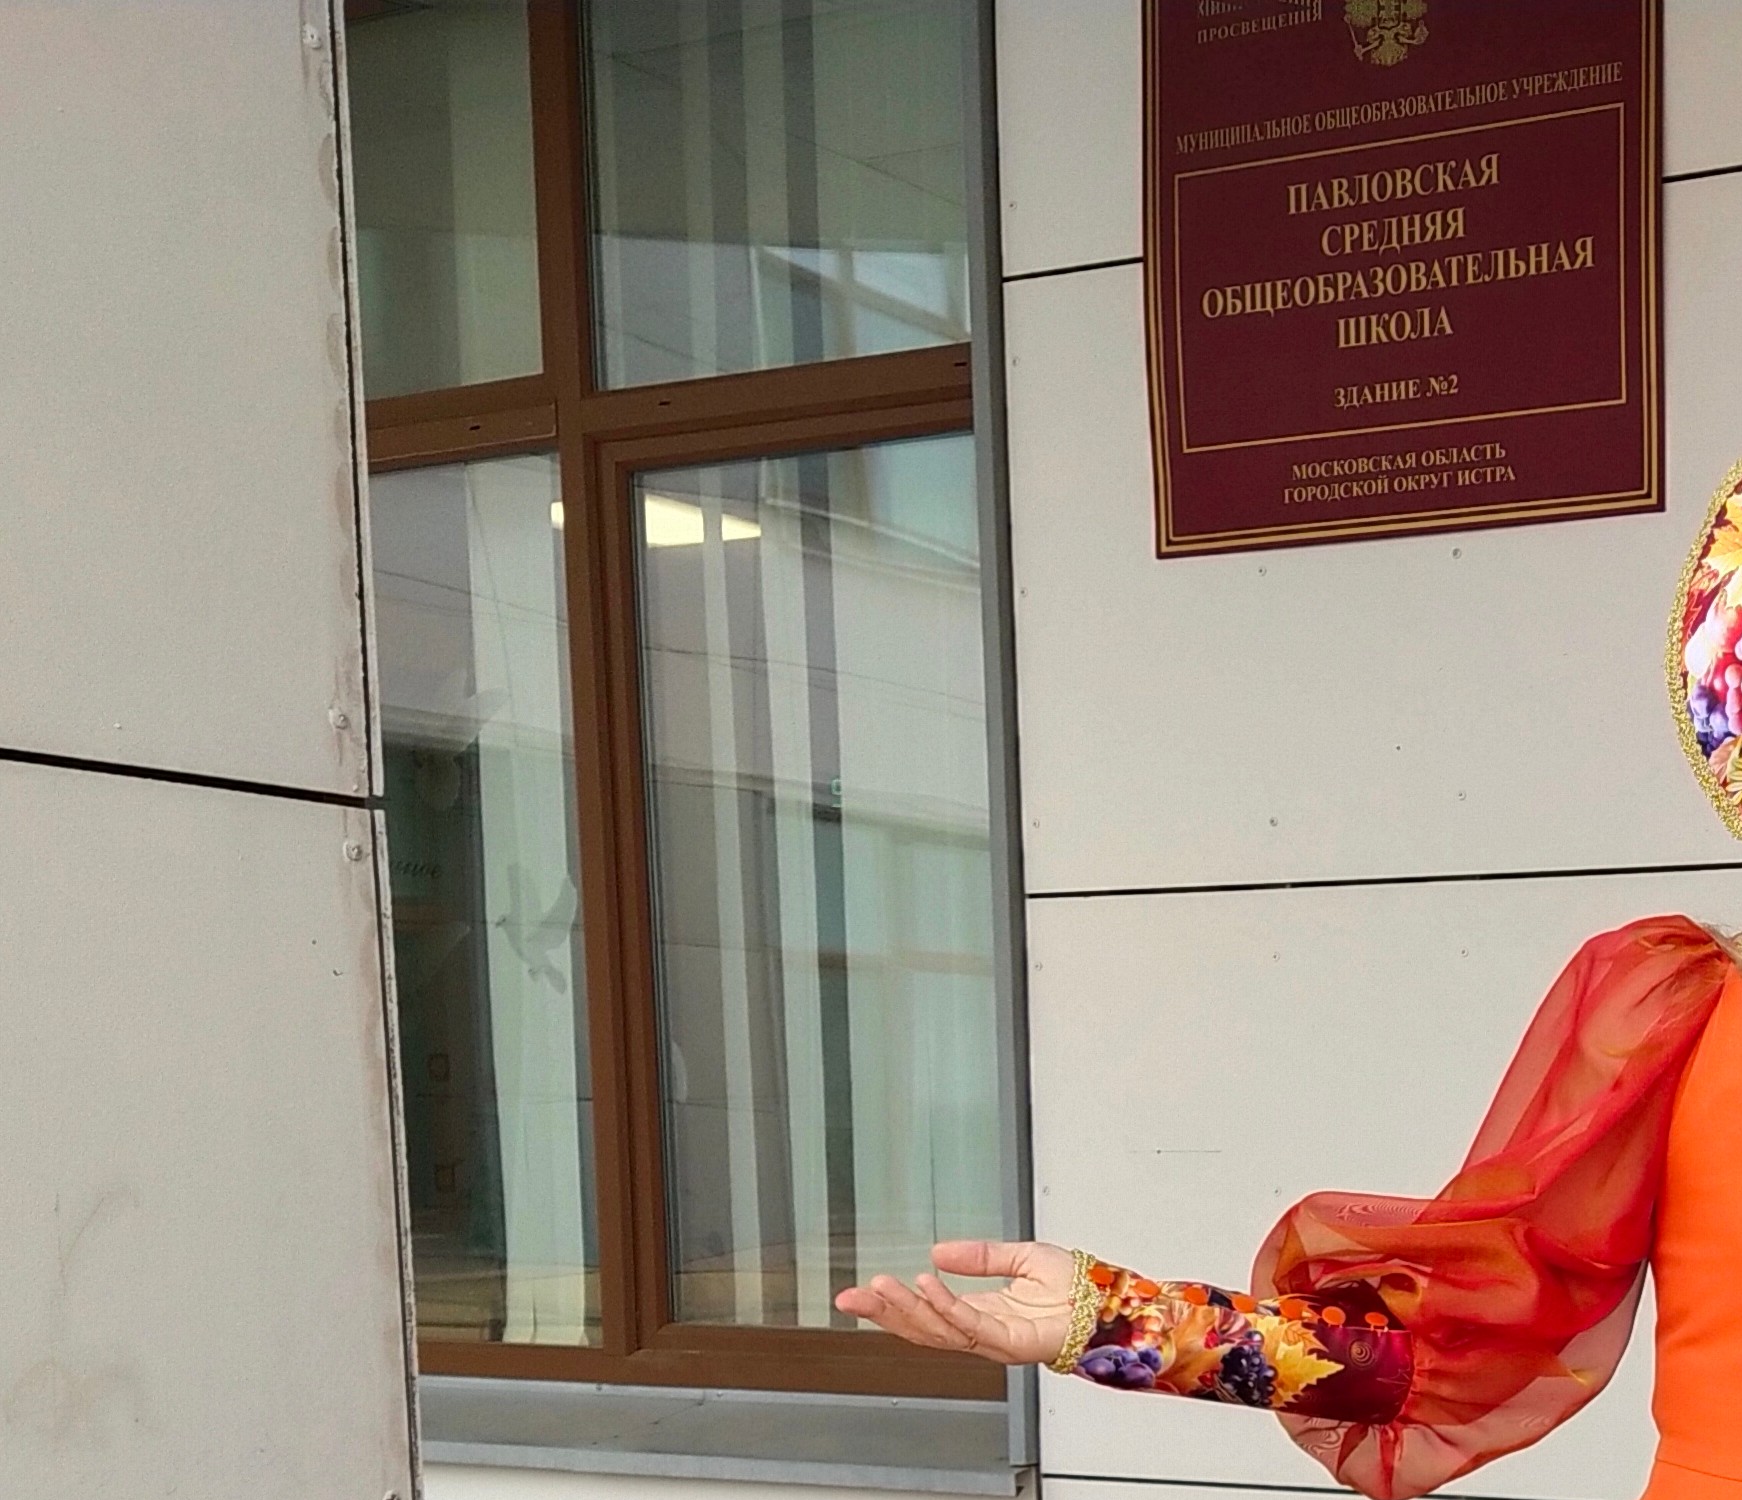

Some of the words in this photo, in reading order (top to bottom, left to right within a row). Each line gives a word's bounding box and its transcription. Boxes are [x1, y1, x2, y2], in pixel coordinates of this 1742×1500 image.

[1196, 6, 1322, 44] ПРОСВЕЩЕНИЯ
[1176, 114, 1311, 154] МУНИЦИПАЛЬНОЕ
[1314, 80, 1507, 130] ОБЩЕОБРАЗОВАТЕЛЬНОЕ
[1511, 61, 1623, 99] УЧРЕЖДЕНИЕ
[1287, 153, 1500, 214] ПАВЛОВСКАЯ
[1320, 207, 1466, 257] СРЕДНЯЯ
[1201, 236, 1595, 319] ОБЩЕОБРАЗОВАТЕЛЬНАЯ
[1336, 305, 1454, 349] ШКОЛА
[1333, 378, 1421, 410] ЗДАНИЕ
[1426, 374, 1459, 398] №2
[1292, 451, 1417, 481] МОСКОВСКАЯ
[1421, 442, 1506, 468] ОБЛАСТЬ
[1283, 474, 1389, 504] ГОРОДСКОЙ
[1393, 471, 1452, 493] ОКРУГ
[1457, 465, 1516, 486] ИСТРА
